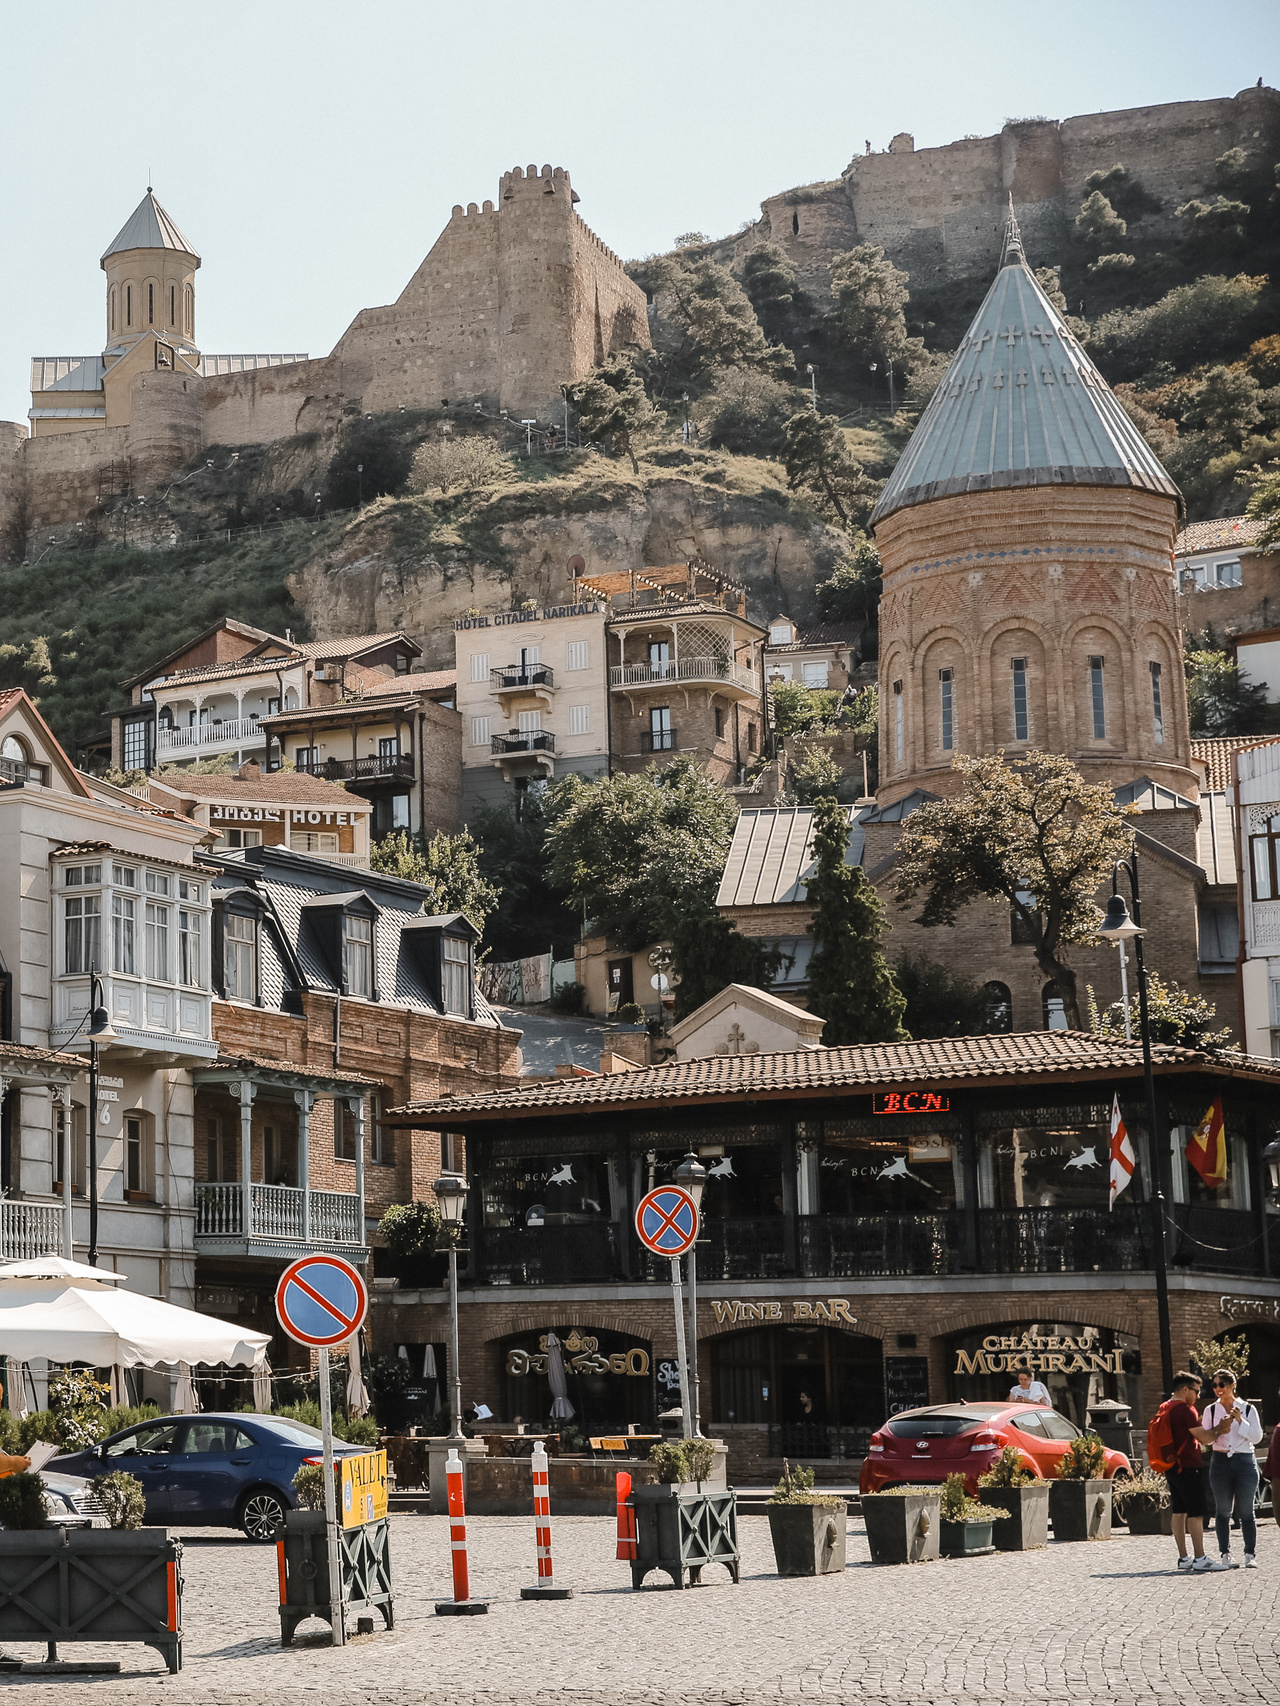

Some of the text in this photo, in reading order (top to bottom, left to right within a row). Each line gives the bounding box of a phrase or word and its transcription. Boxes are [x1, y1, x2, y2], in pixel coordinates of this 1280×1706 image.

[455, 603, 599, 631] HOTEL CITADEL NARIKALA
[293, 810, 360, 826] HOTEL
[97, 1090, 120, 1101] OTEL
[884, 1092, 942, 1111] BCN
[100, 1103, 111, 1124] 6
[851, 1166, 878, 1177] BCN
[711, 1299, 857, 1323] WINE BAR
[982, 1332, 1093, 1350] CHÂTEAU
[505, 1347, 650, 1377] მურანი
[954, 1349, 1126, 1374] MUKHRANI
[348, 1453, 382, 1488] VALET
